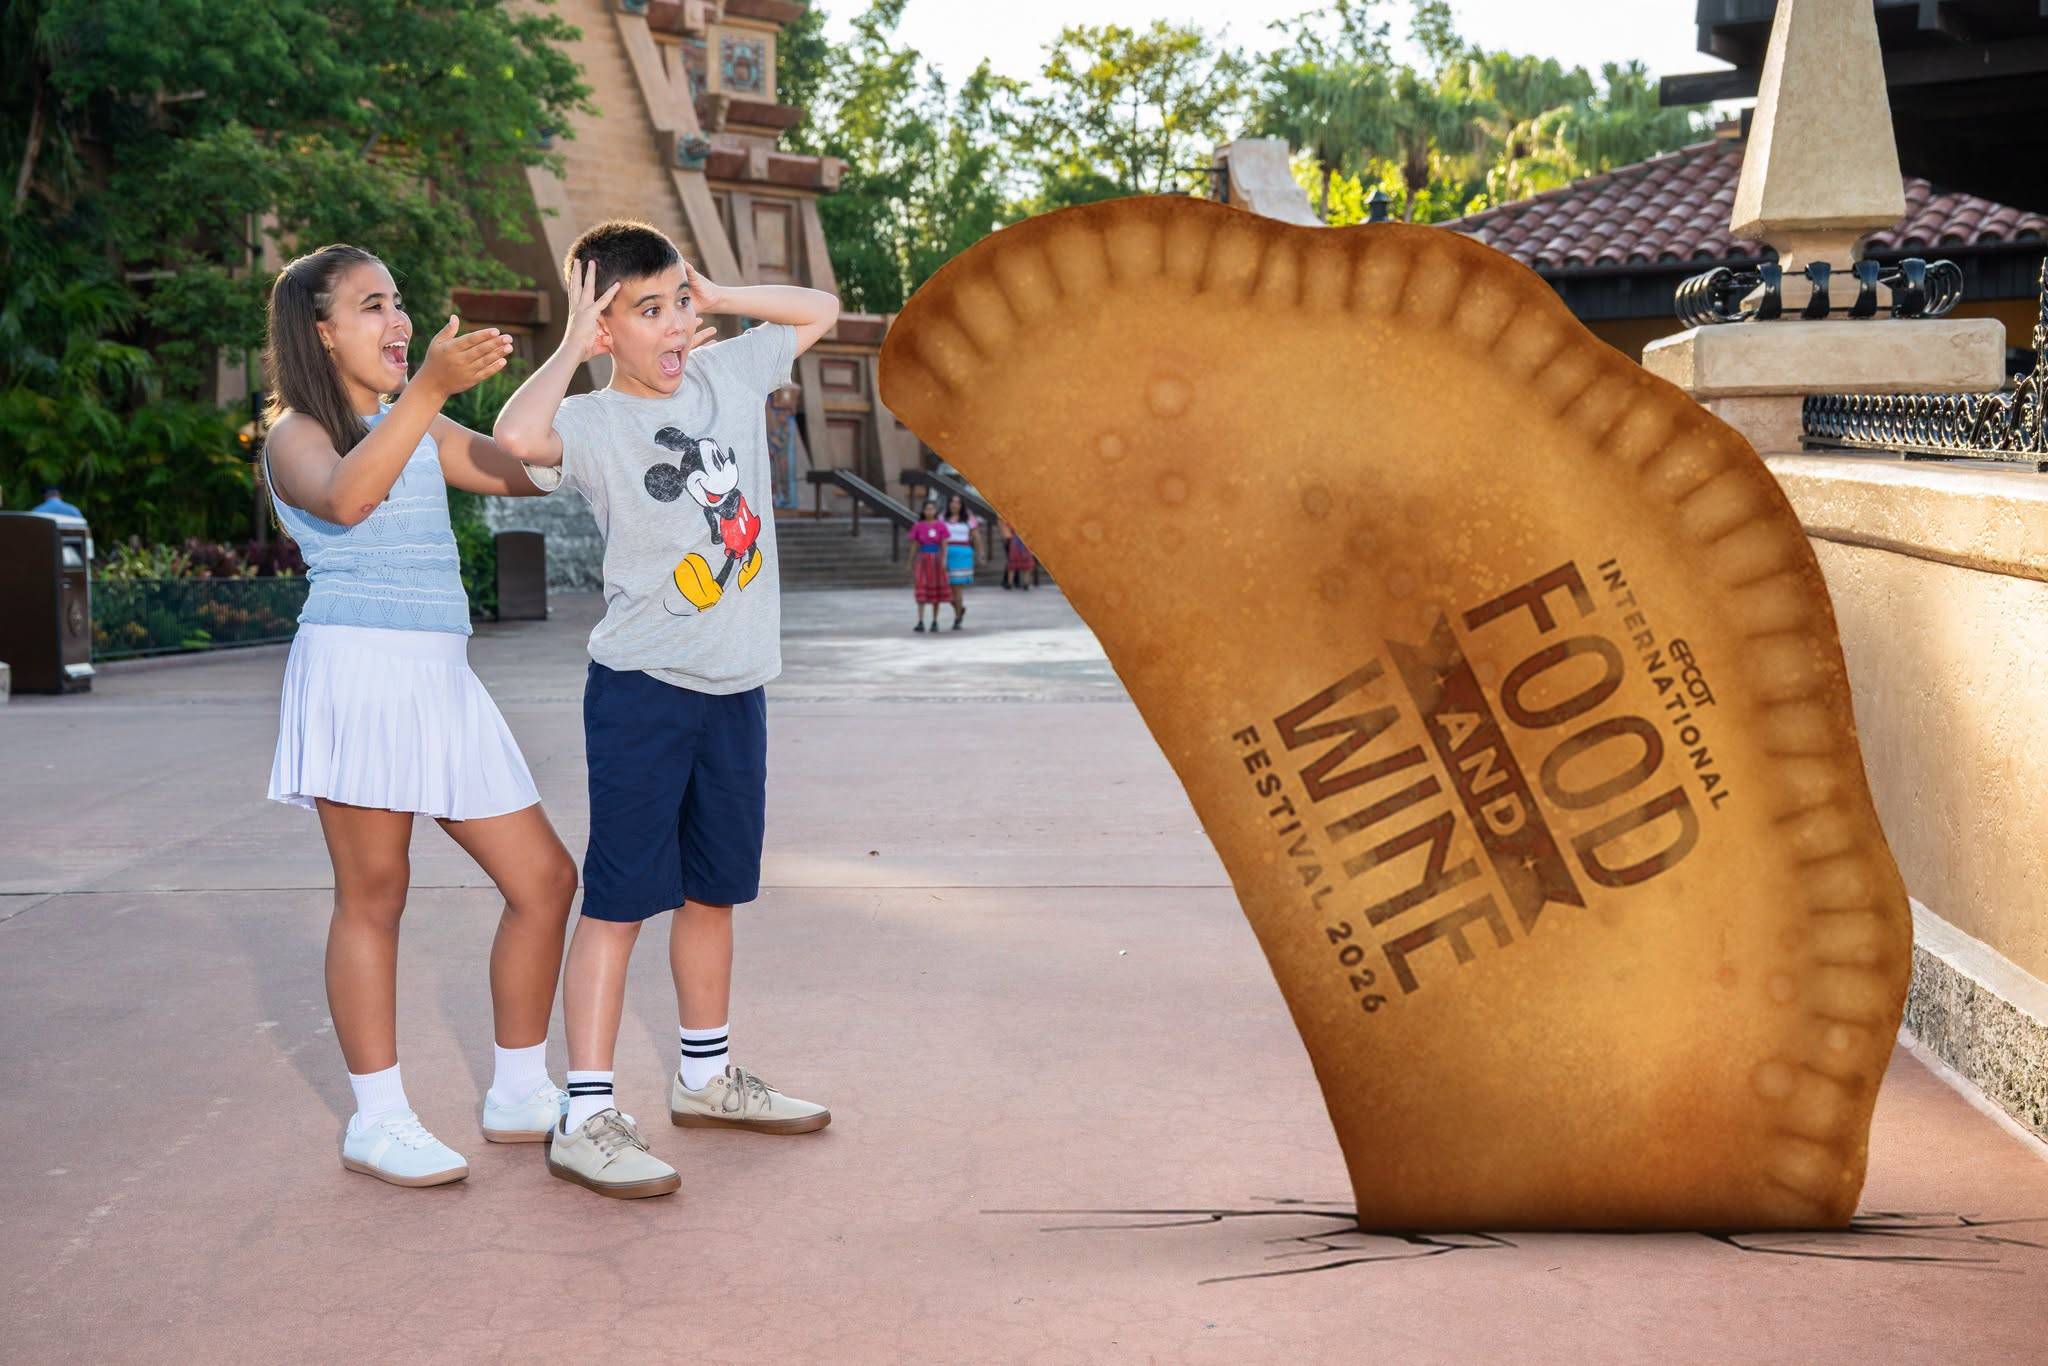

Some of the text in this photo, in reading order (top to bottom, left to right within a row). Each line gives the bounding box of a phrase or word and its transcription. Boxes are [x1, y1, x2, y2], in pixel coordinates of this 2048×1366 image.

[1436, 710, 1527, 836] AND
[1461, 559, 1700, 888] FOOD
[1597, 557, 1730, 811] INTERNATIONAL
[1668, 637, 1716, 708] EPCOT
[1232, 725, 1388, 1014] FESTIVAL 2026
[1273, 658, 1515, 995] WINE
